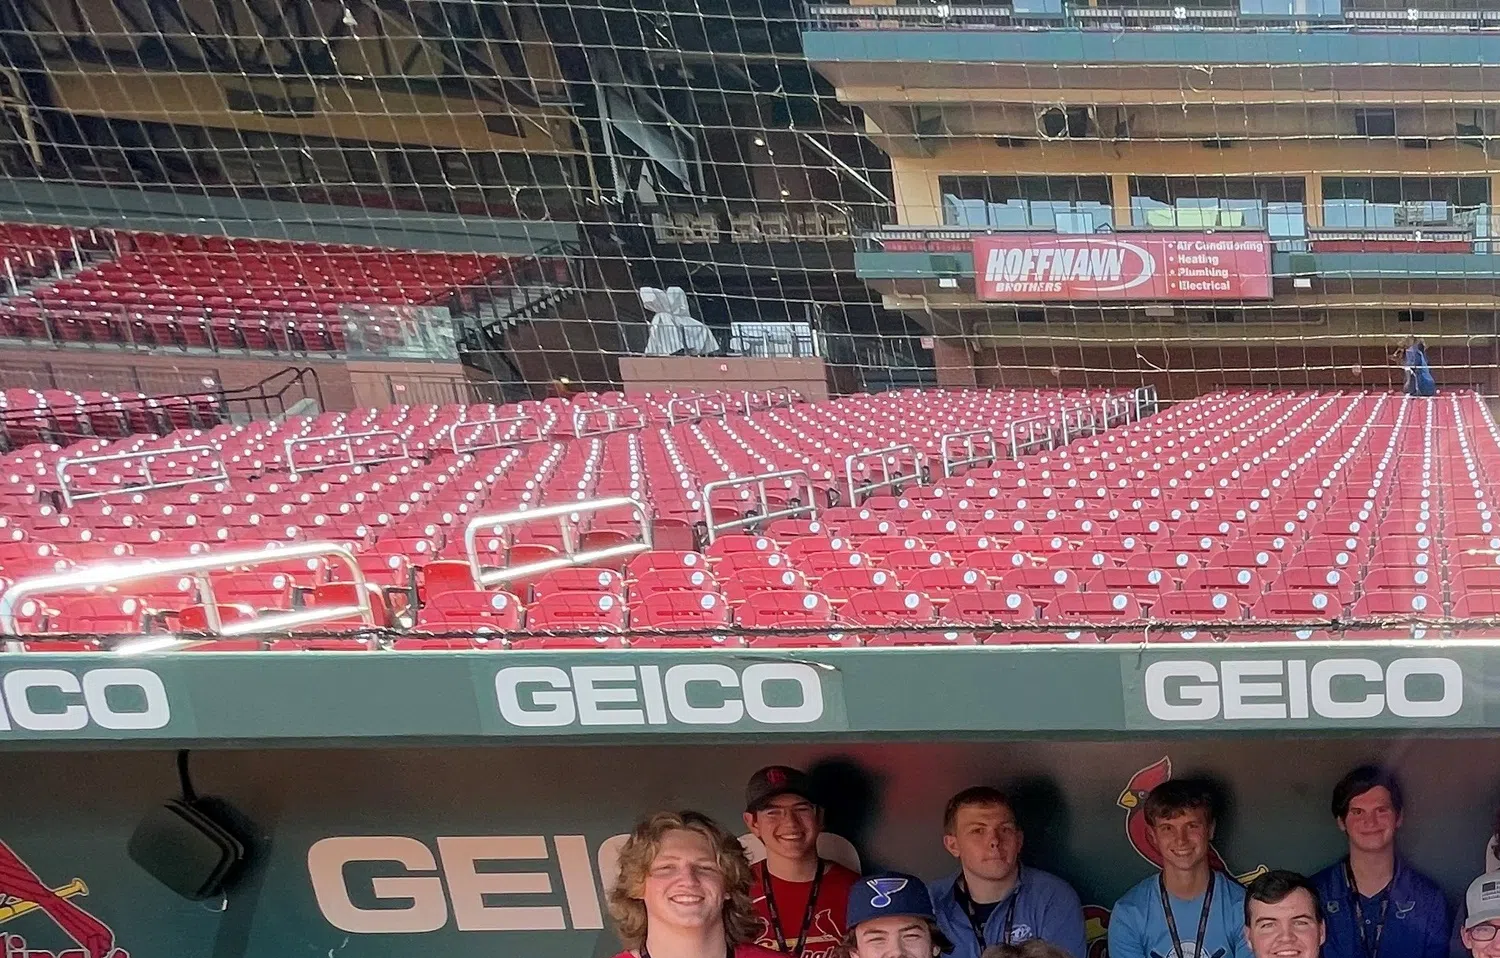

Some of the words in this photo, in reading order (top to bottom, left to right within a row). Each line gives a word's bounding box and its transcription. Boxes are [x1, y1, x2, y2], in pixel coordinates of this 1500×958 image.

[1176, 241, 1193, 250] Air
[1195, 240, 1264, 253] Conditioning
[985, 248, 1126, 282] HOFFMANN
[1178, 254, 1219, 266] Heating
[1177, 267, 1229, 279] Plumbing
[995, 281, 1062, 292] BROTHERS
[1179, 280, 1230, 291] Electrical
[1144, 657, 1463, 721] GEICO
[495, 663, 823, 728] GEICO
